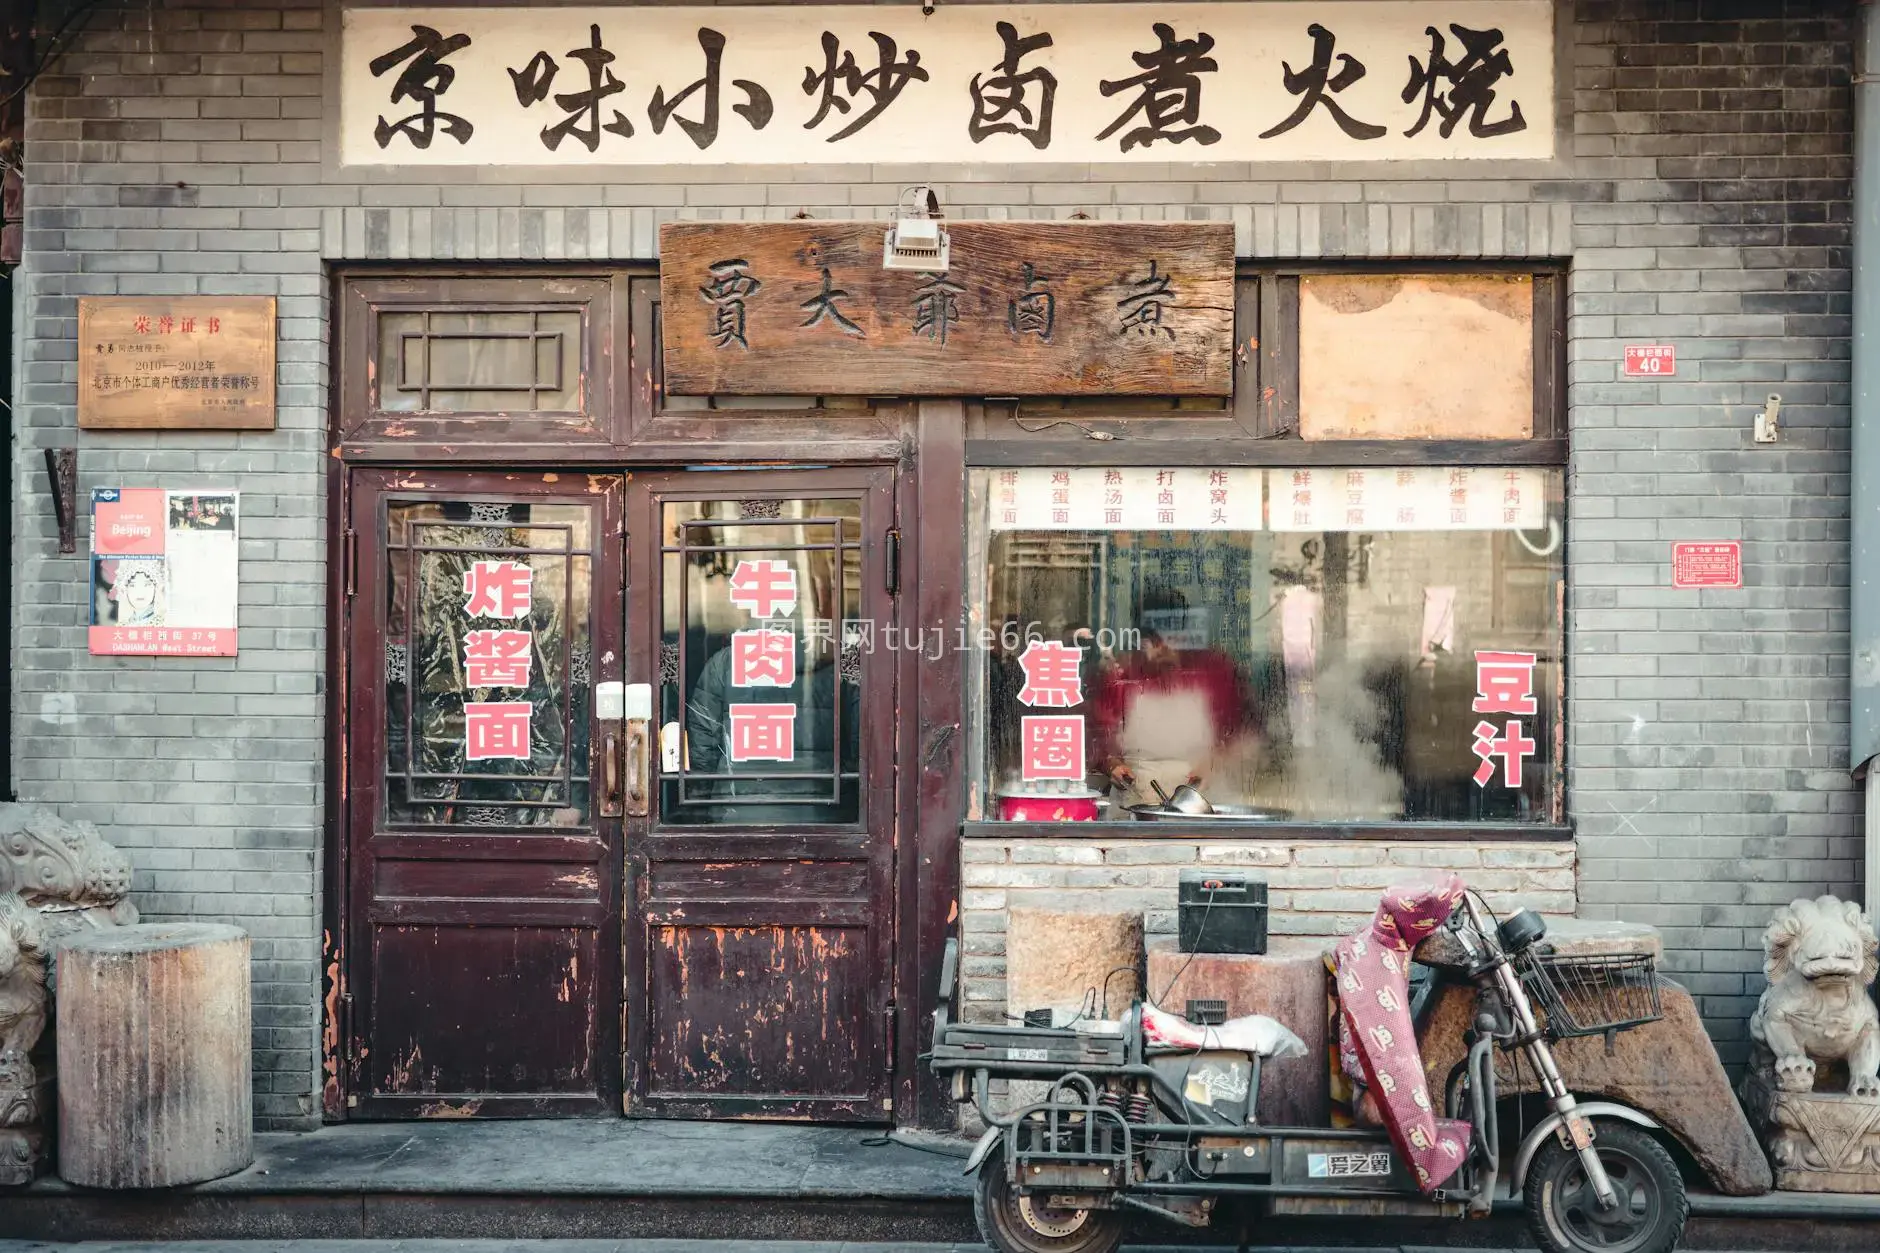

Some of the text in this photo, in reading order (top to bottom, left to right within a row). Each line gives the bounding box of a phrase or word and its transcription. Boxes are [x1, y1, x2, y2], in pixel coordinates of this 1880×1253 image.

[369, 20, 1528, 154] 京味小炒卤煮火烧
[133, 315, 221, 335] 荣誉证书
[92, 376, 261, 390] 北京市个体工商户优秀经营者荣誉称号
[1639, 358, 1660, 373] 40
[1000, 470, 1018, 525] 排骨面
[1051, 470, 1070, 525] 鸡蛋面
[1104, 470, 1123, 525] 热汤面
[1157, 470, 1175, 525] 打卤面
[1210, 470, 1229, 525] 炸窝头
[1346, 470, 1365, 525] 麻豆腐
[1450, 470, 1468, 525] 炸酱面
[1503, 470, 1521, 525] 牛肉面
[112, 523, 152, 538] Beijing
[186, 643, 217, 653] Street
[463, 560, 533, 761] 炸酱面
[729, 559, 797, 762] 牛肉面
[1017, 640, 1086, 782] 焦圈
[1472, 650, 1538, 788] 豆汁
[1328, 1152, 1391, 1177] 爱之翼
